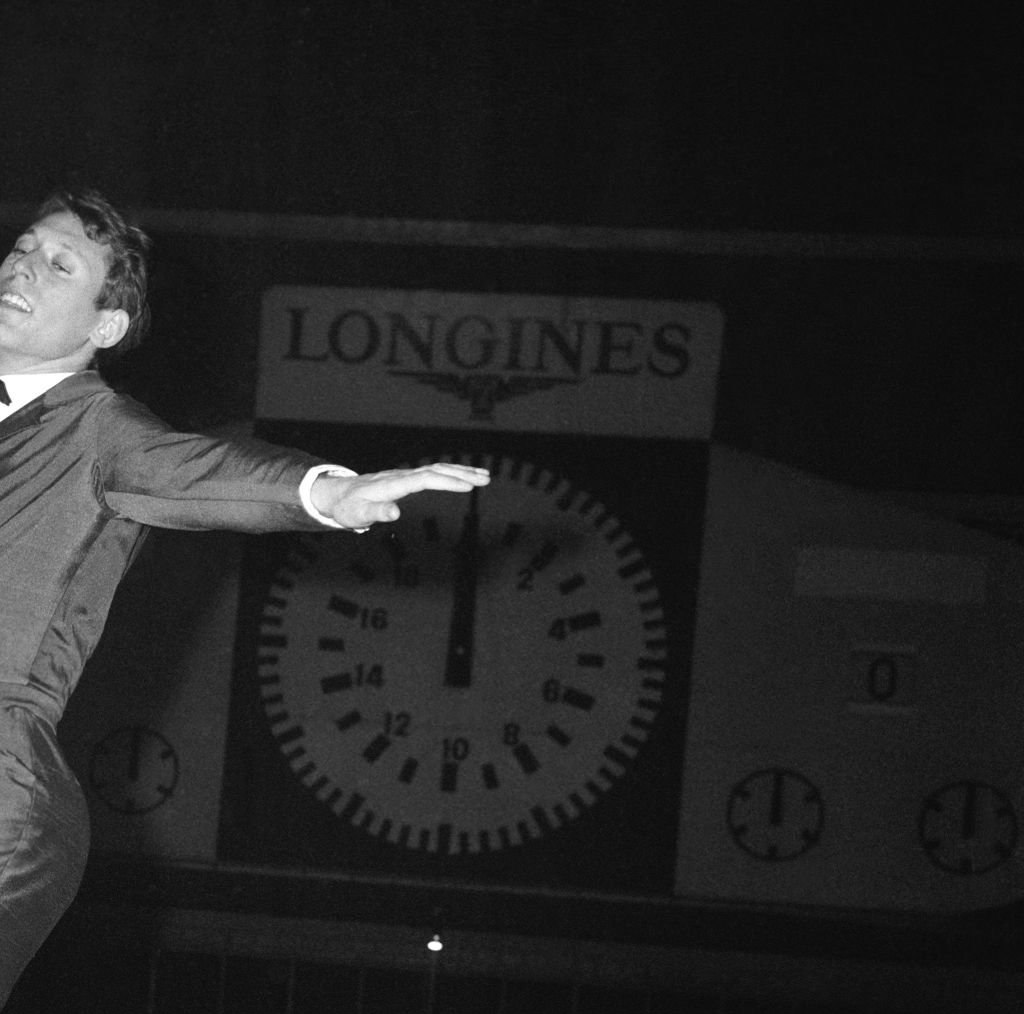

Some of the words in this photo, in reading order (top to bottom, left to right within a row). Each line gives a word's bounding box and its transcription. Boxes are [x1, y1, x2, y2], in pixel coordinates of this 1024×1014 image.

[282, 306, 692, 378] LONGINES
[517, 568, 535, 590] 2
[361, 607, 388, 630] 16
[548, 618, 568, 640] 4
[356, 664, 384, 687] 14
[542, 679, 561, 702] 6
[384, 713, 411, 737] 12
[503, 723, 520, 745] 8
[443, 738, 469, 760] 10
